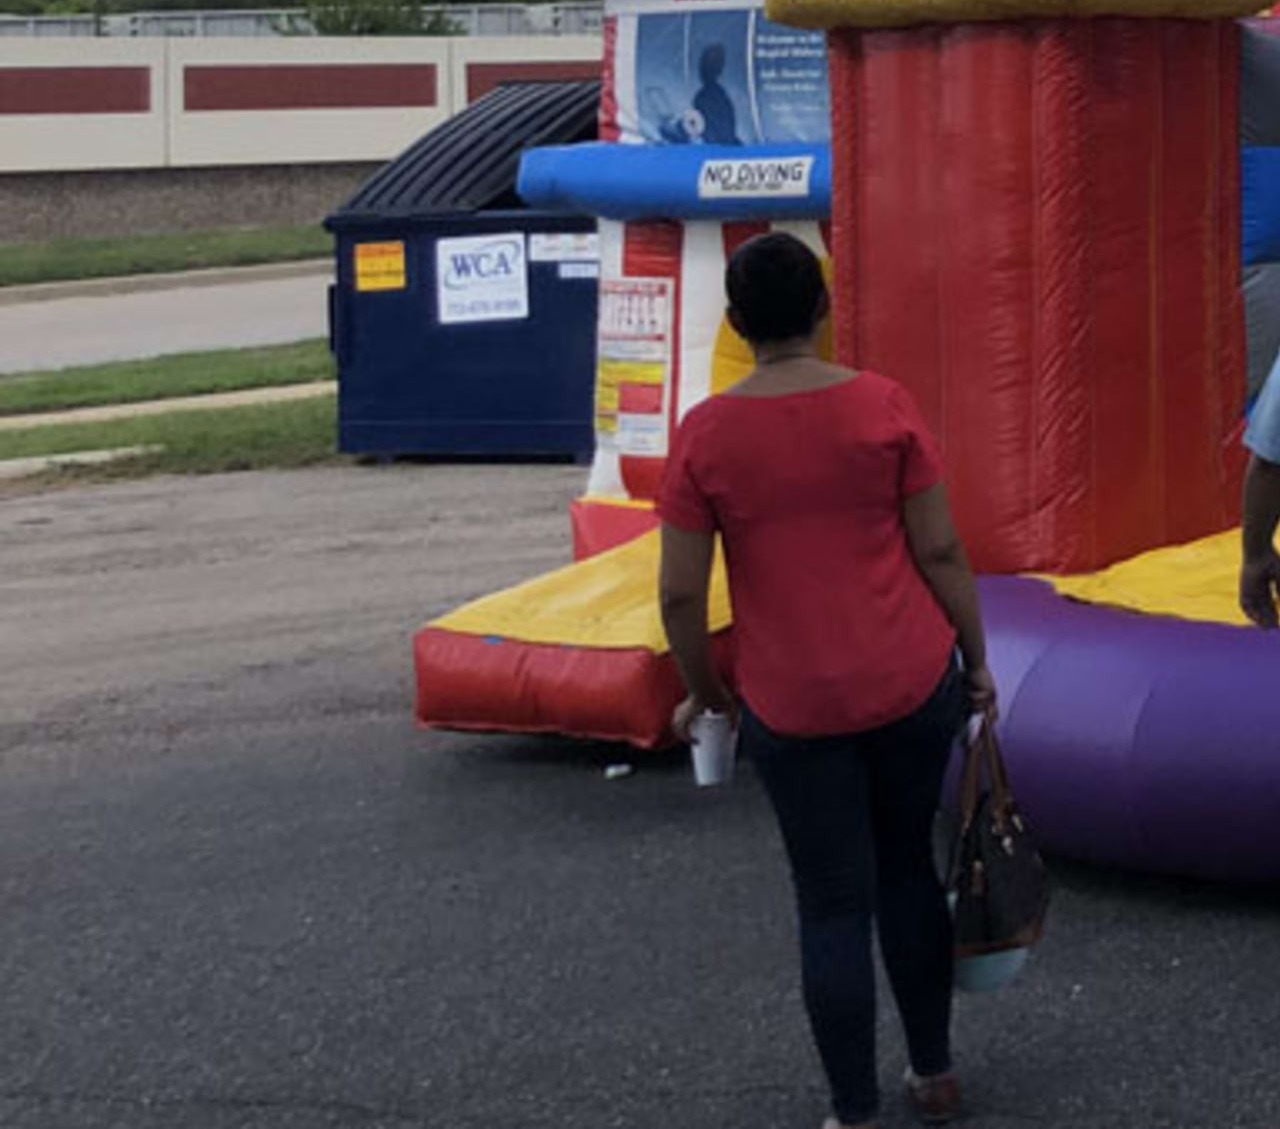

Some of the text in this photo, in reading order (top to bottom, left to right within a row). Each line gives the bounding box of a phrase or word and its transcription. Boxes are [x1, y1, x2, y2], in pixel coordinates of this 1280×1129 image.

[704, 162, 804, 184] NO DIVING
[451, 251, 512, 280] WCA
